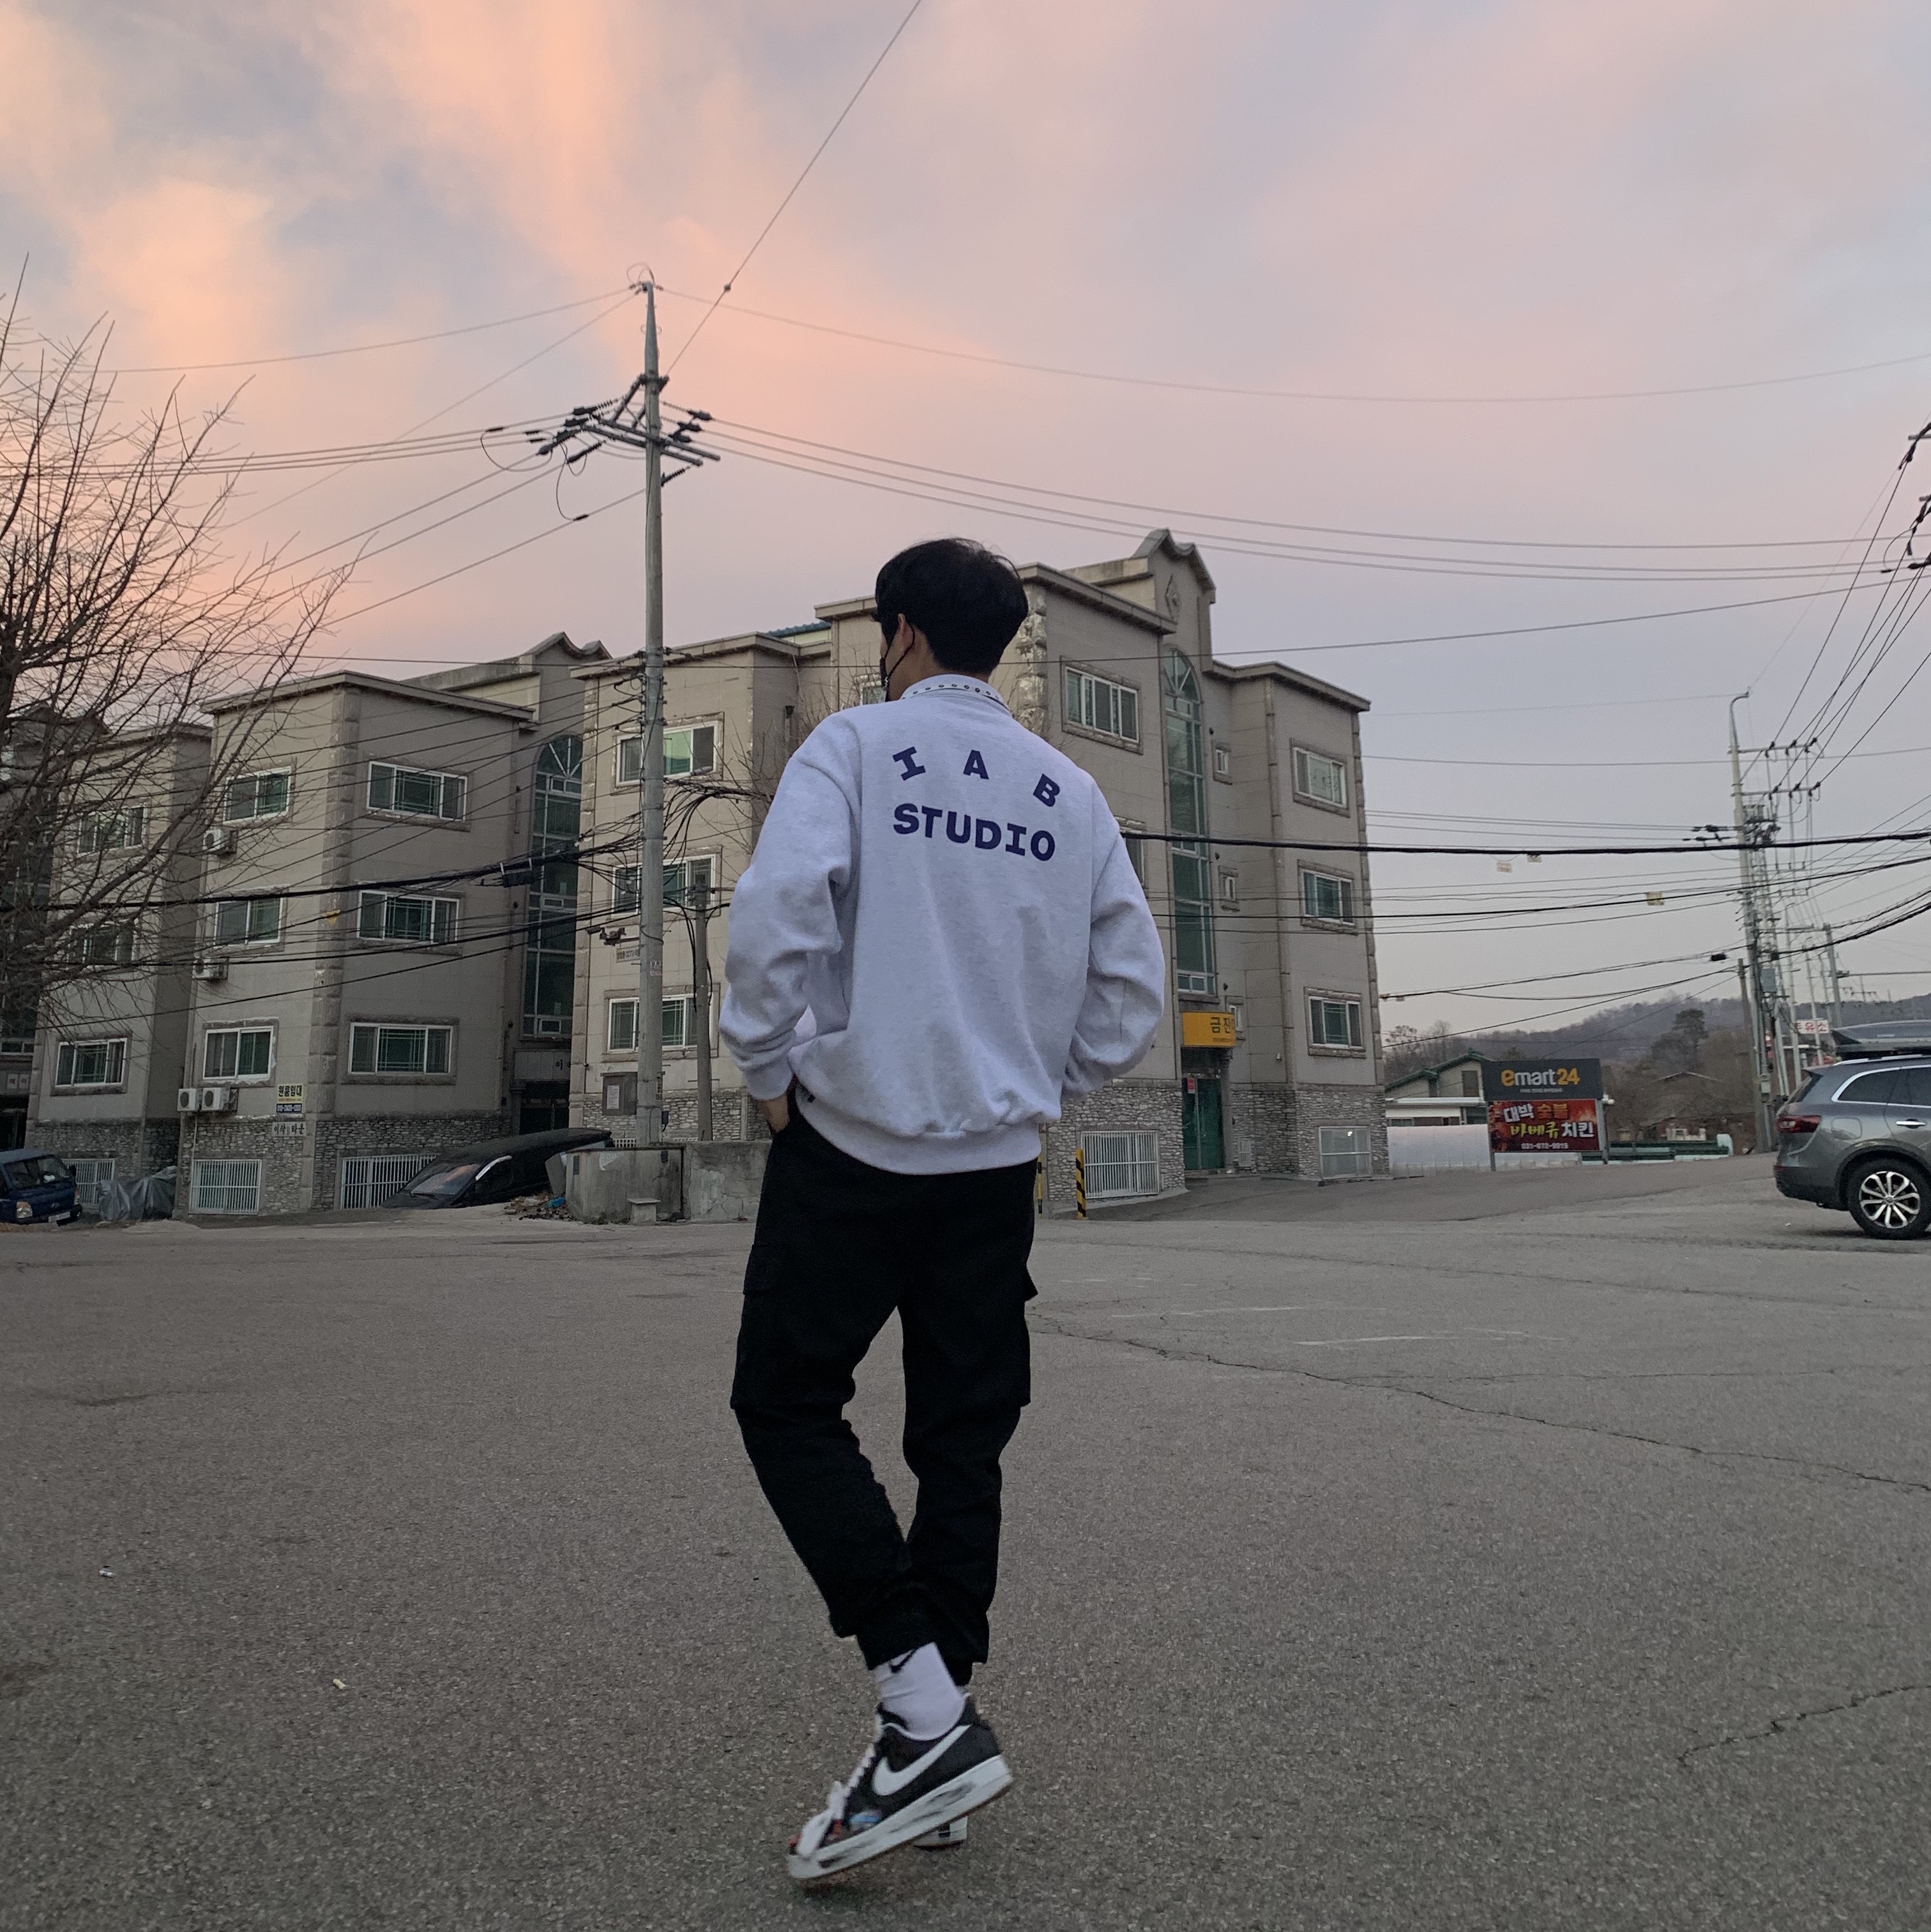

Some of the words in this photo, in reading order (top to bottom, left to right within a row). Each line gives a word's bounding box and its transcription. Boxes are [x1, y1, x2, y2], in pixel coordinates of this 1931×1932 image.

[893, 803, 1056, 862] STUDIO
[1501, 1067, 1580, 1086] emart24
[1503, 1103, 1534, 1123] 대박
[1510, 1121, 1559, 1139] 바베큐
[1561, 1122, 1595, 1138] 치킨
